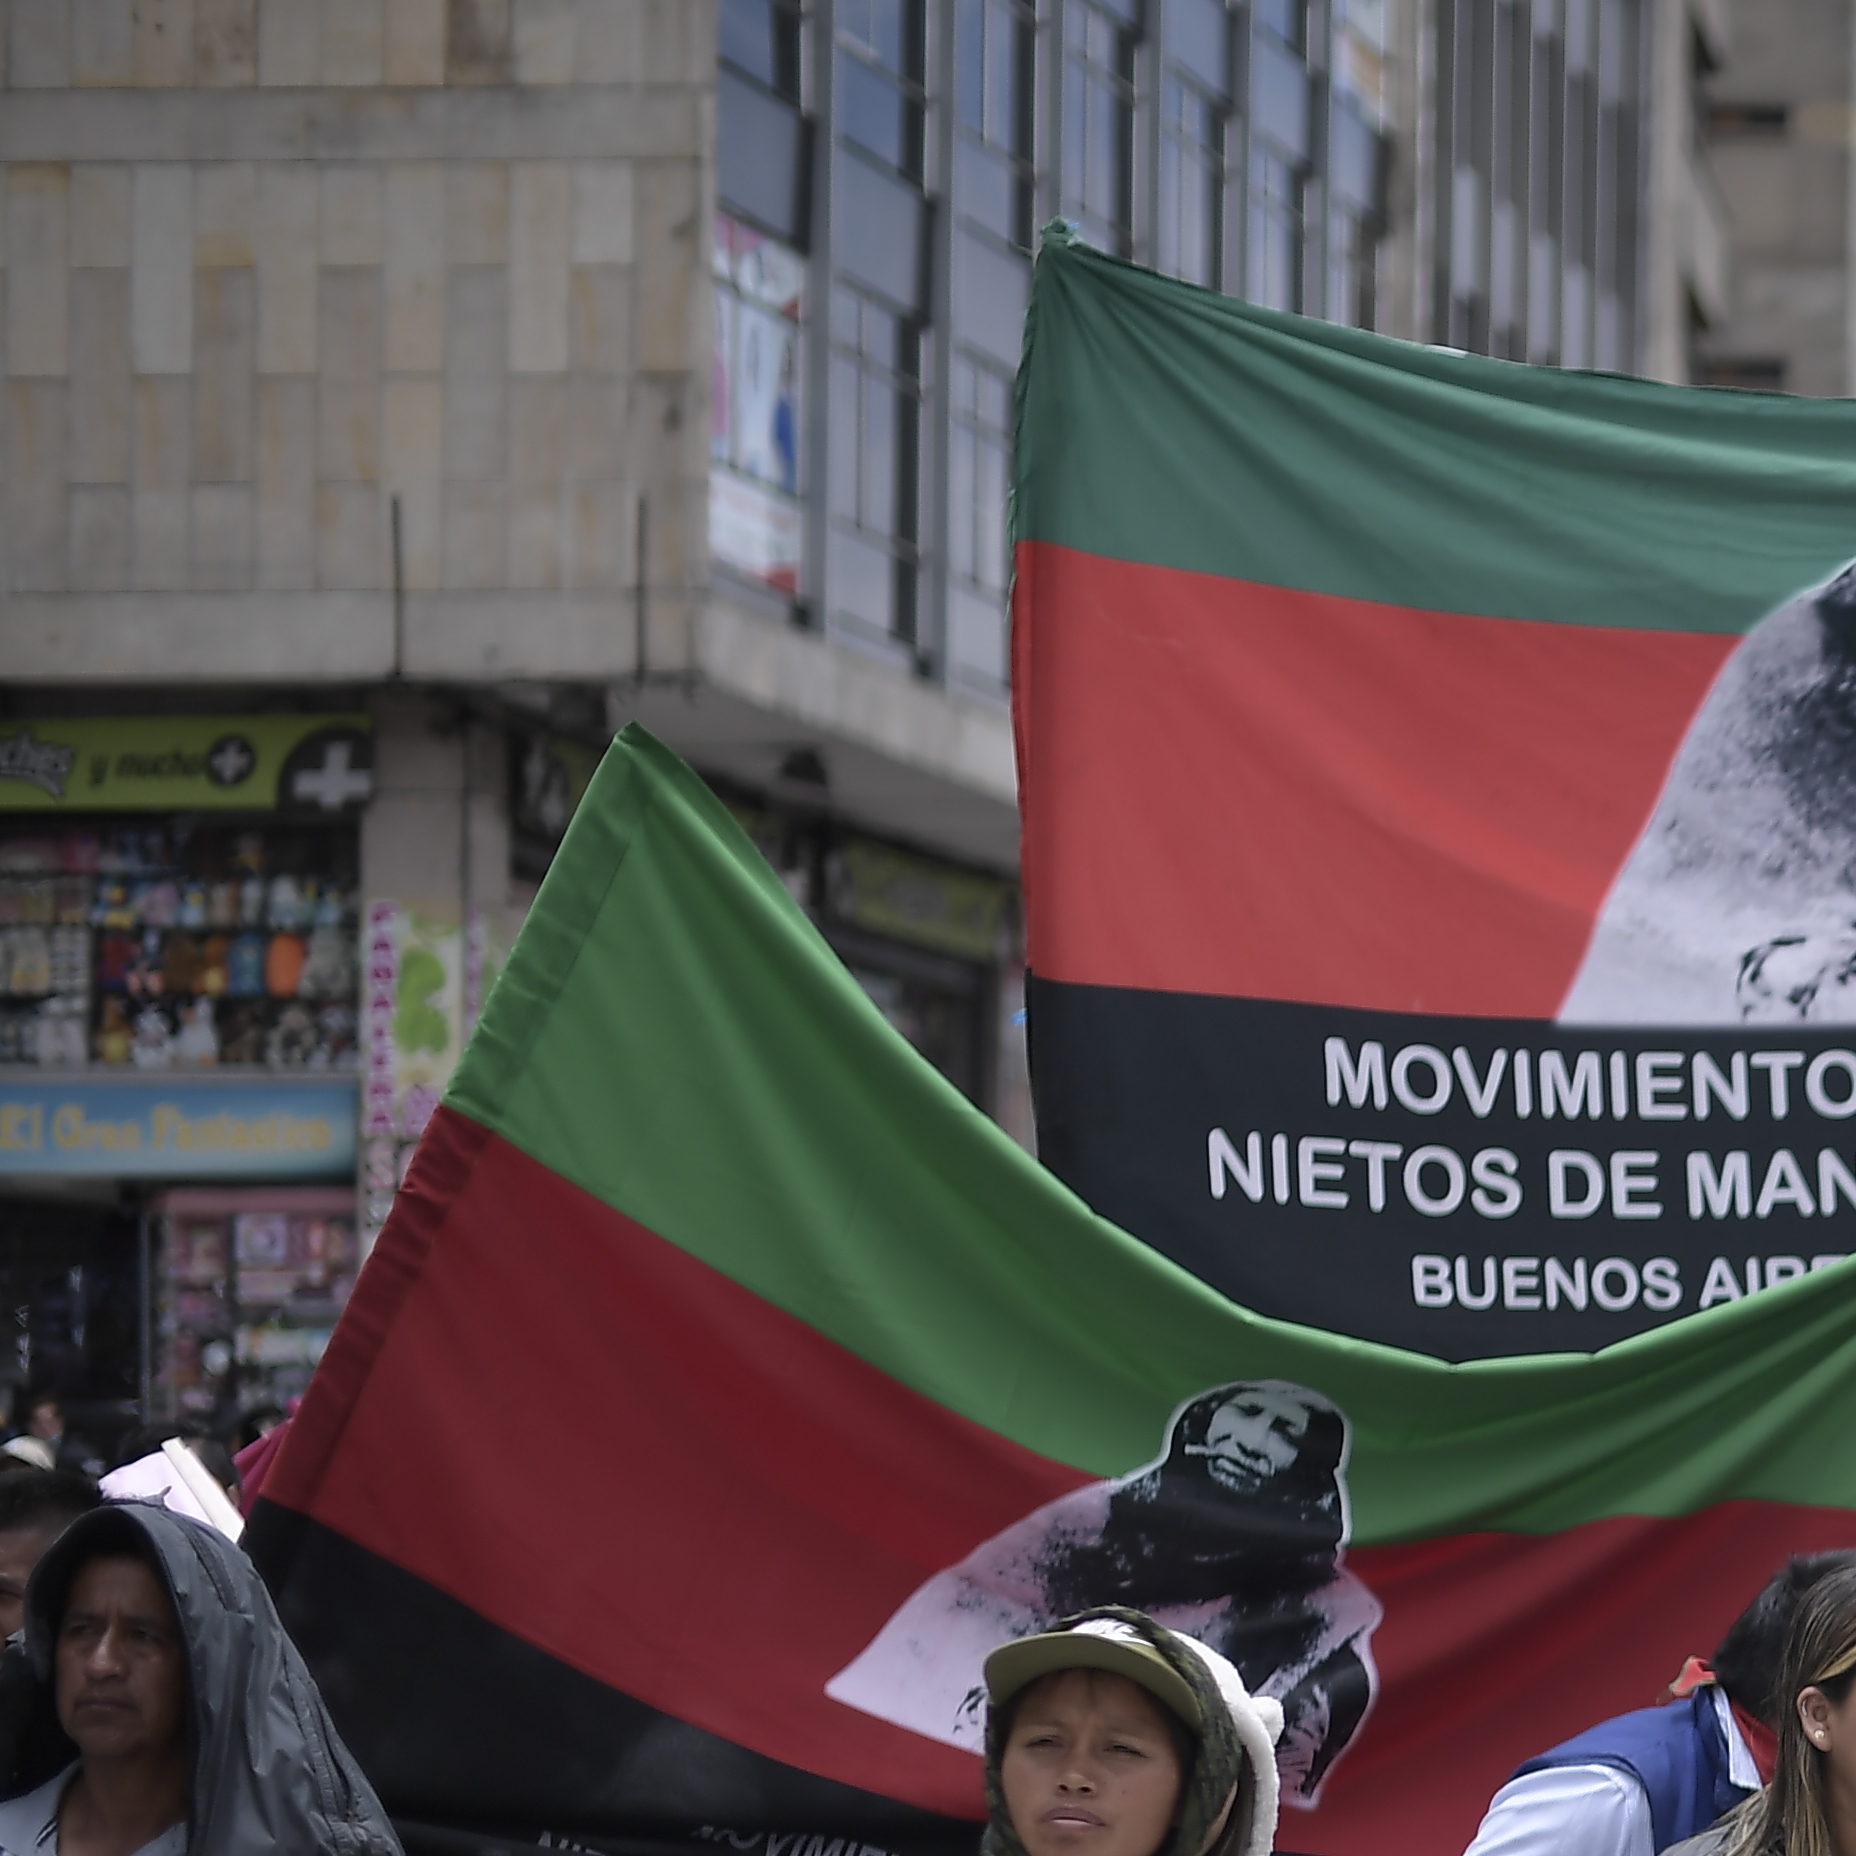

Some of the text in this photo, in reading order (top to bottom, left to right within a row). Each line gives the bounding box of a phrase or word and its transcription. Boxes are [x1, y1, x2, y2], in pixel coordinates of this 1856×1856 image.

[1207, 1126, 1525, 1220] NIETOS
[1546, 1148, 1665, 1221] DE
[1410, 1253, 1685, 1312] BUENOS
